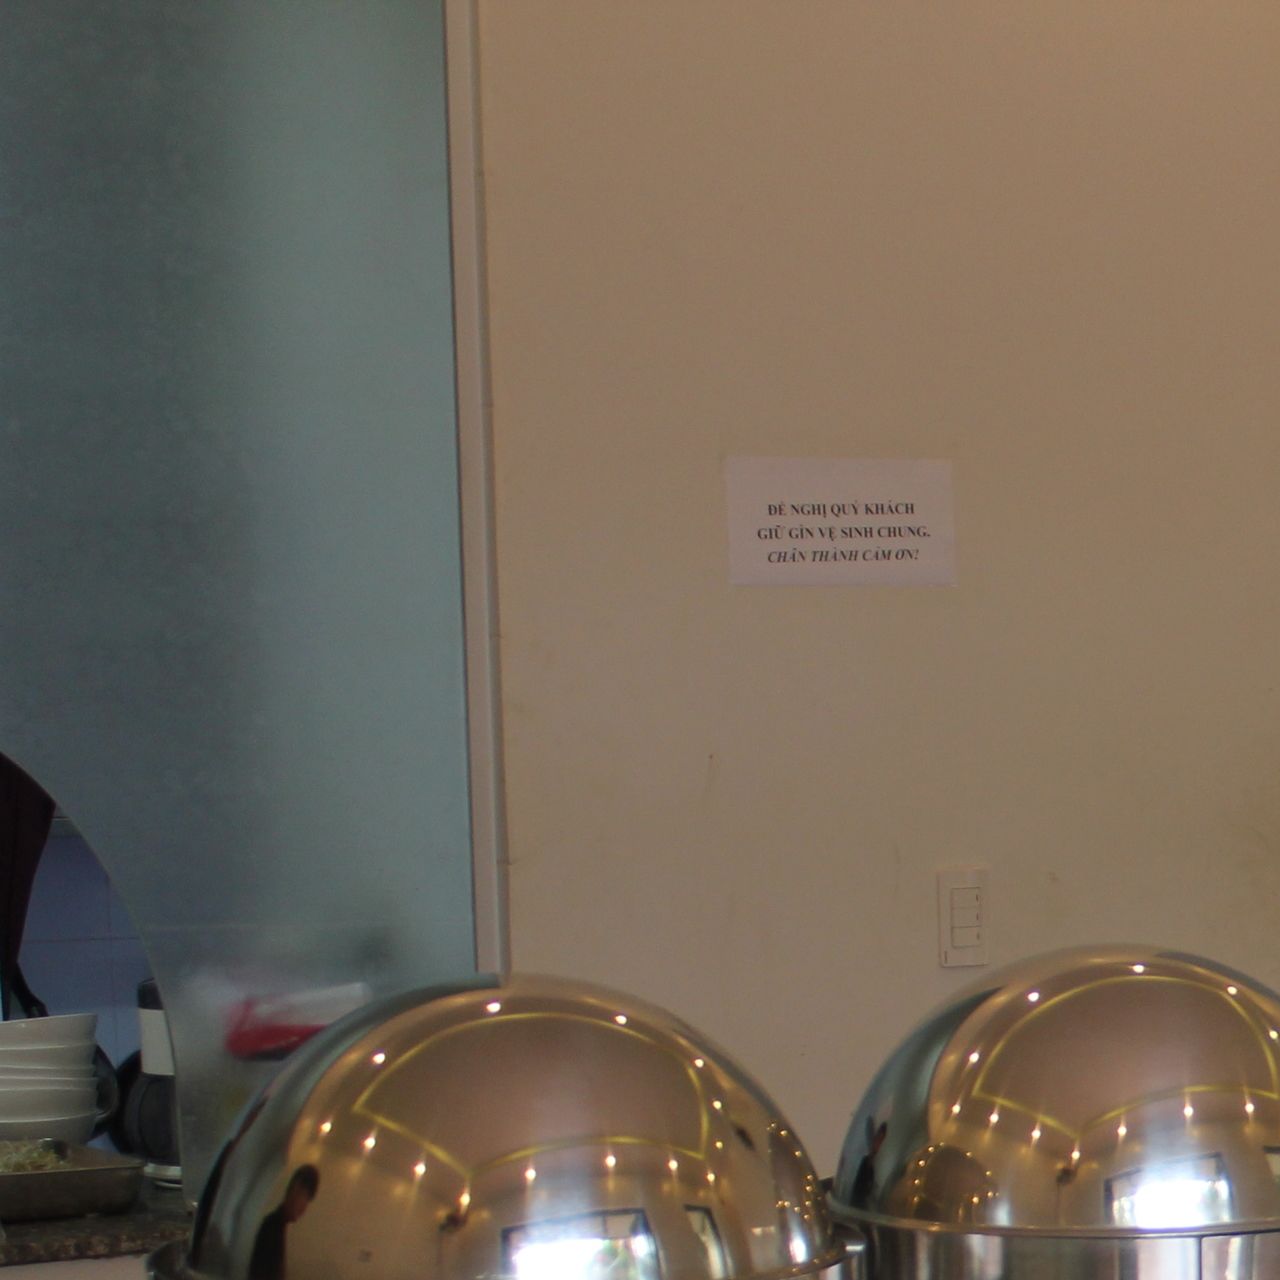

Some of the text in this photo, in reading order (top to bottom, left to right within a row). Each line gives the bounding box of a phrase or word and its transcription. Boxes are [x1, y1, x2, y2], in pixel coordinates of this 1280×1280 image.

[790, 502, 827, 518] NGHỊ
[830, 500, 860, 517] QUÝ
[864, 500, 915, 515] KHÁCH
[840, 526, 873, 538] SINH
[877, 525, 931, 538] CHUNG.
